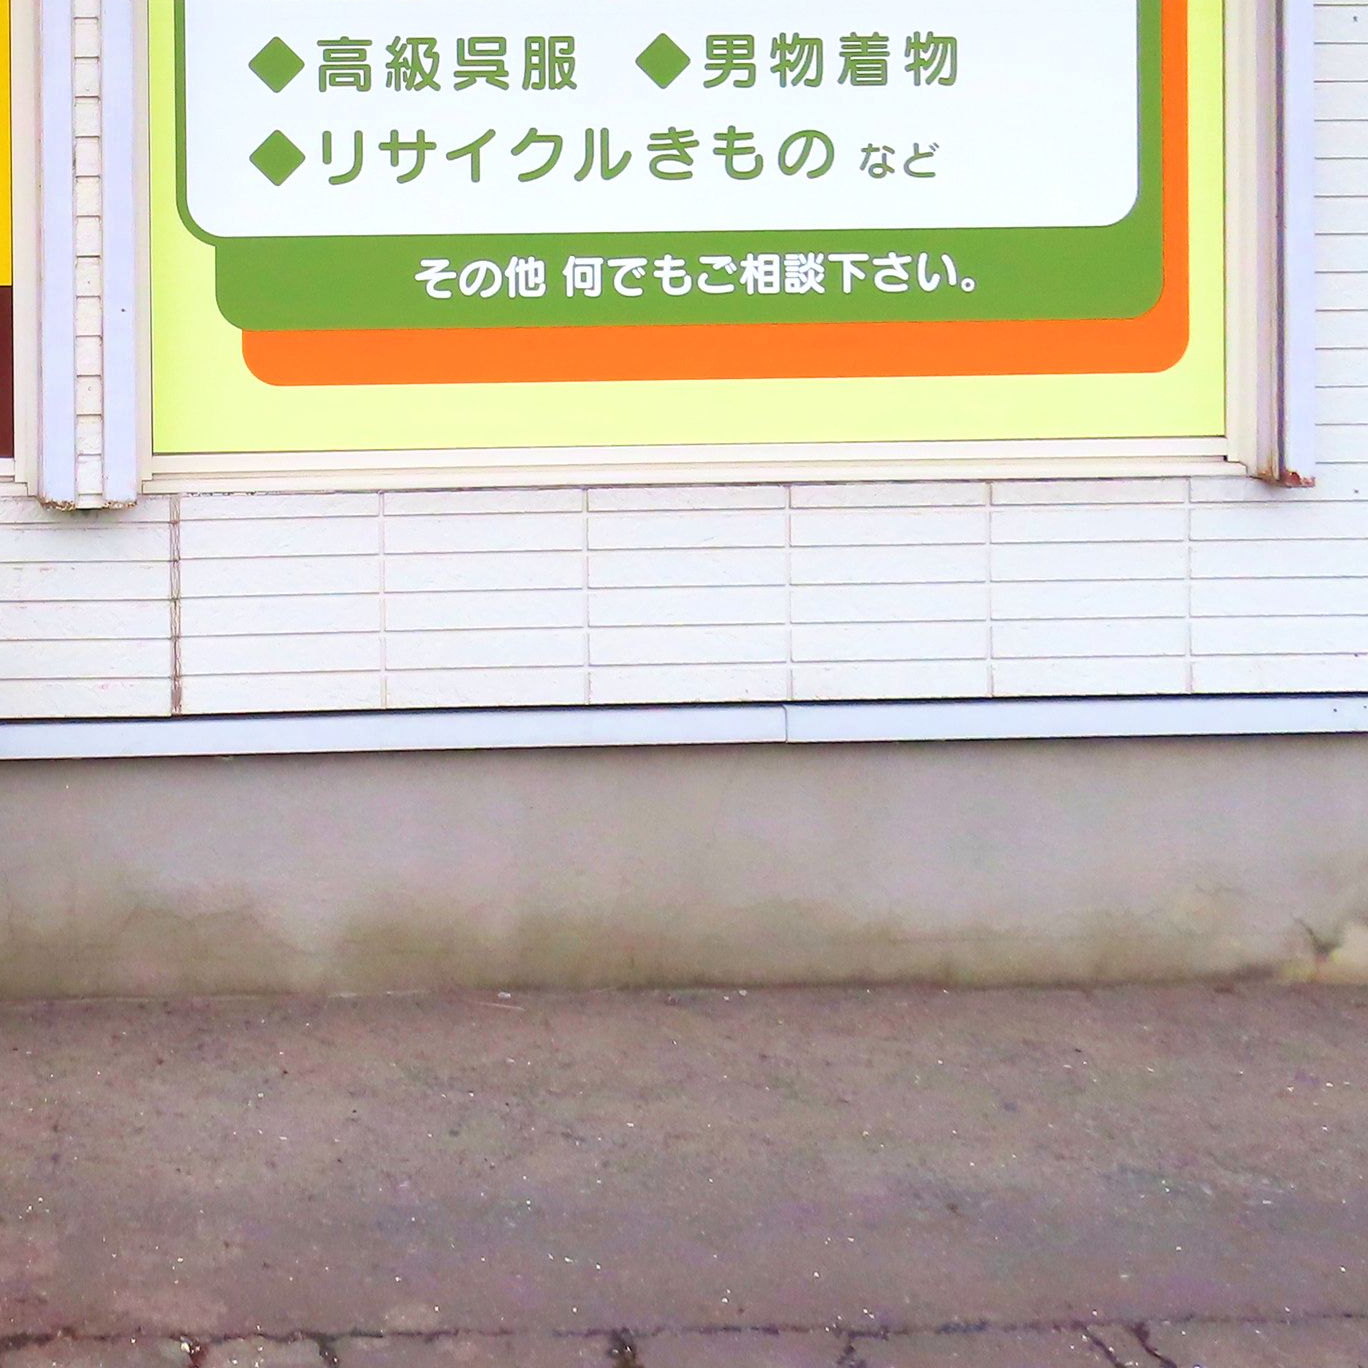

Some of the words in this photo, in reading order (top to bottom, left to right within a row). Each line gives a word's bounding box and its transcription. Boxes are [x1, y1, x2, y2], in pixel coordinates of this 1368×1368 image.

[316, 34, 578, 93] 高級呉服
[702, 30, 959, 89] 男物着物
